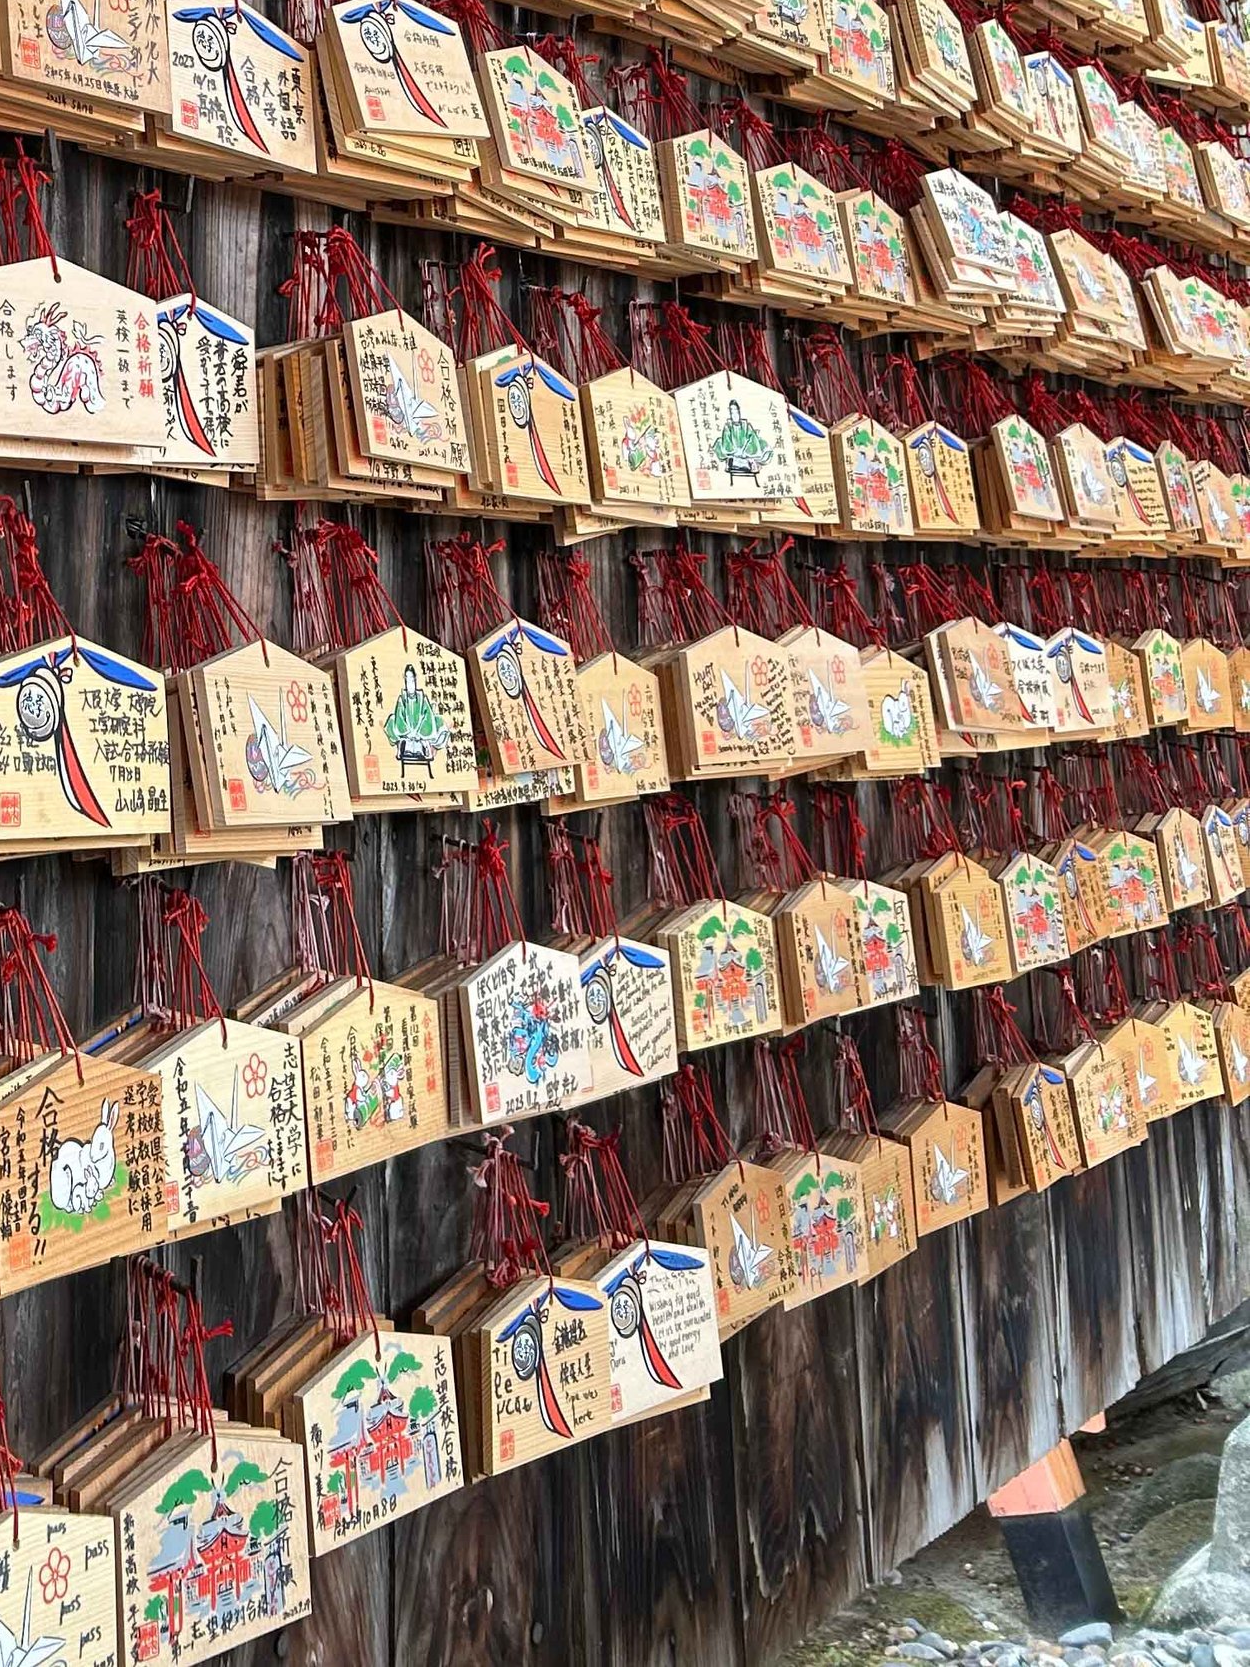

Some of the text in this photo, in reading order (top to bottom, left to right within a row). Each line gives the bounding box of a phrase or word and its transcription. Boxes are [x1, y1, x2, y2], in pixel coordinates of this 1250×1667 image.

[239, 55, 261, 107] 合格
[262, 77, 278, 129] 大学
[0, 298, 19, 402] 合格します
[114, 309, 134, 410] 英検一級まで
[133, 311, 155, 399] 合格祈願
[146, 1080, 166, 1208] 愛媛県公立
[281, 1042, 303, 1178] 志望大学に
[47, 1522, 67, 1544] pass
[84, 1539, 110, 1572] pass
[78, 1625, 102, 1659] pass
